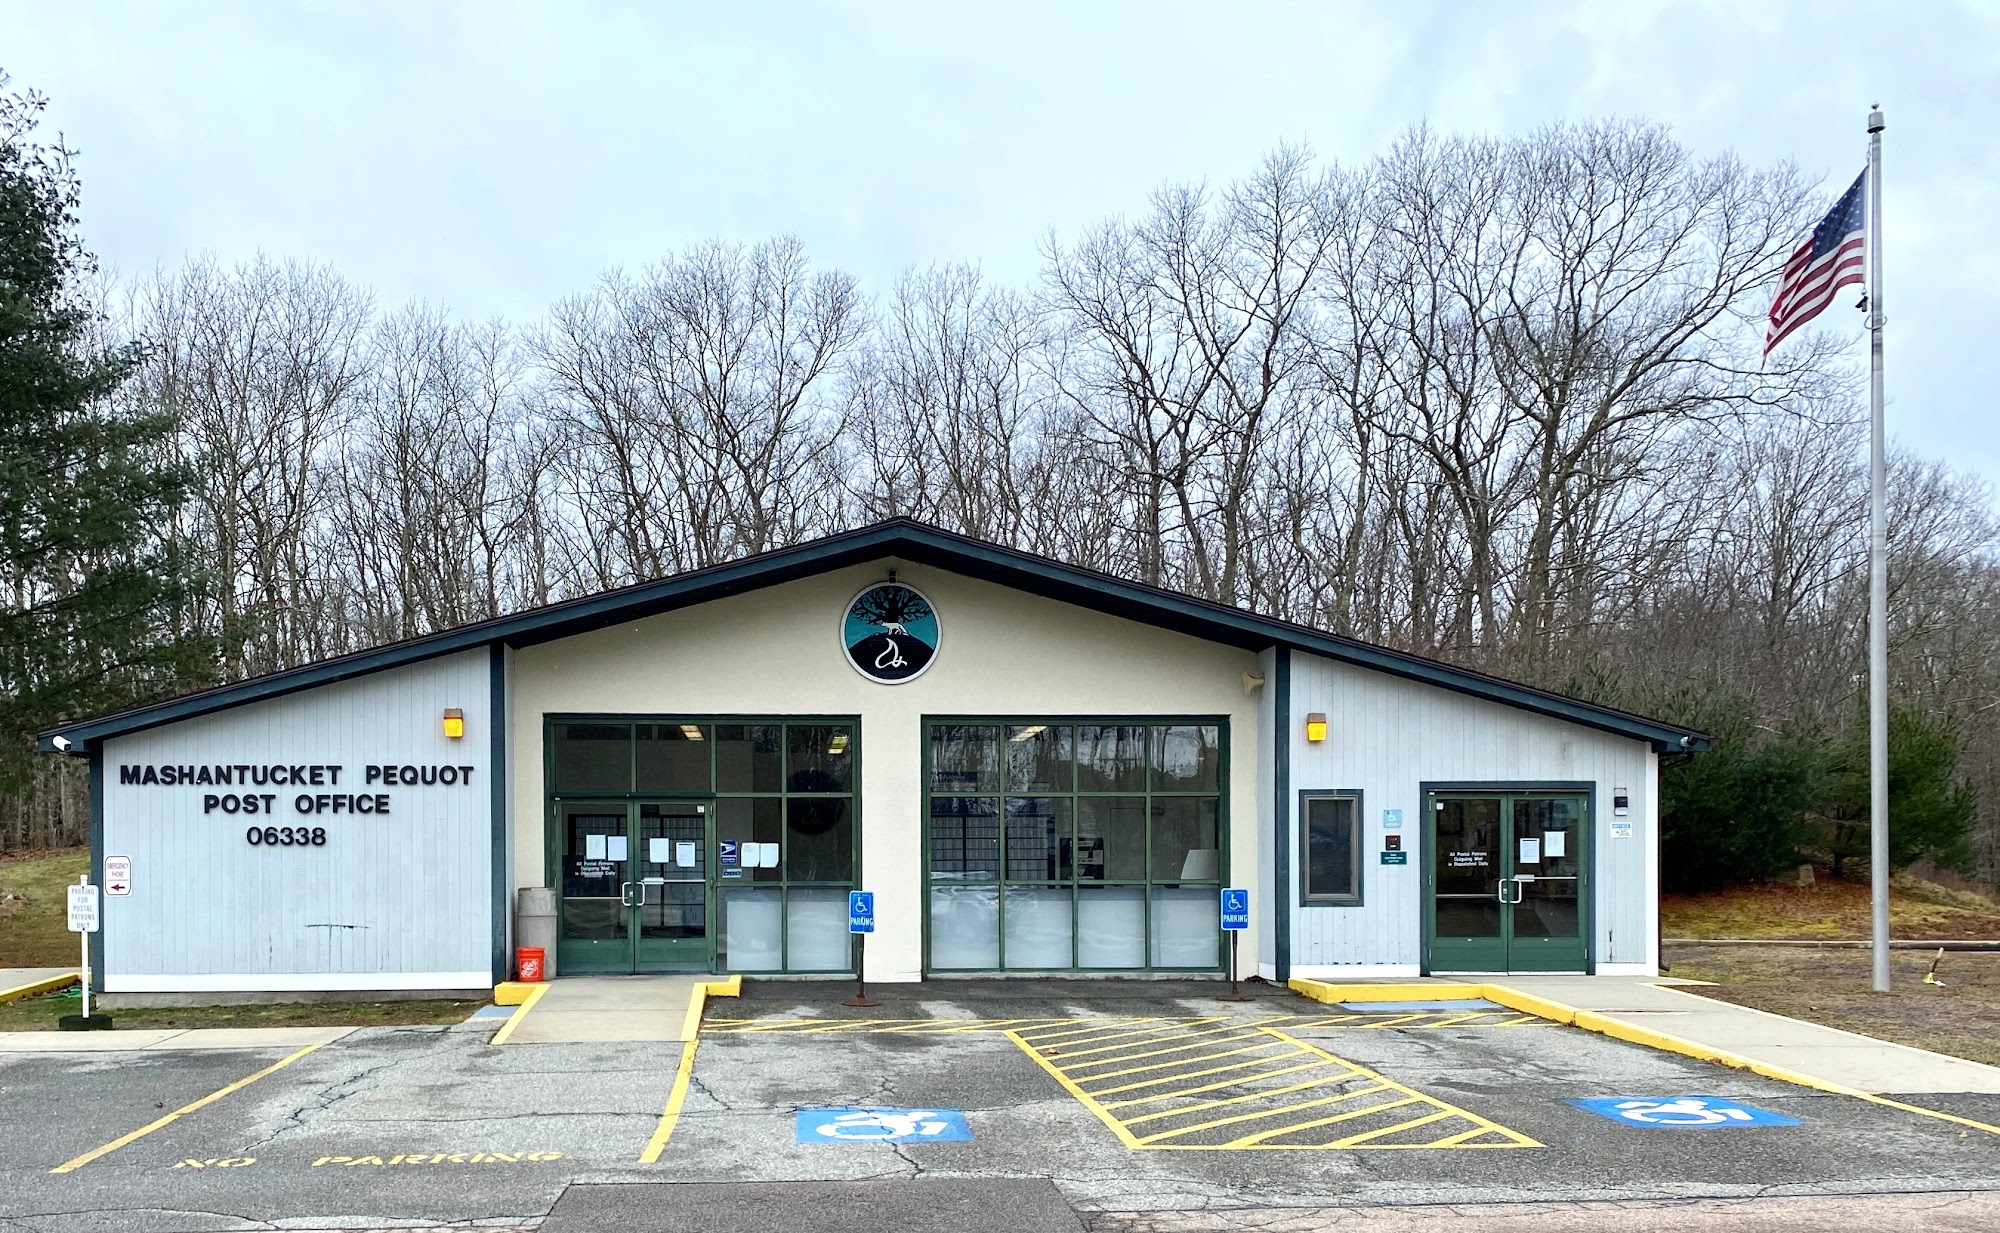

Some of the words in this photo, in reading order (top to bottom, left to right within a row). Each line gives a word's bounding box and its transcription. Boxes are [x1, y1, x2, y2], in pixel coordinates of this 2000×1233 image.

[120, 765, 342, 785] MASHANTUCKET
[366, 766, 474, 785] PEQUOT
[204, 794, 276, 814] POST
[295, 794, 390, 814] OFFICE
[246, 826, 326, 846] 06338
[850, 917, 874, 926] PARKING
[1223, 914, 1248, 922] PARKING
[170, 1157, 257, 1168] NO
[311, 1151, 565, 1166] PARKING
